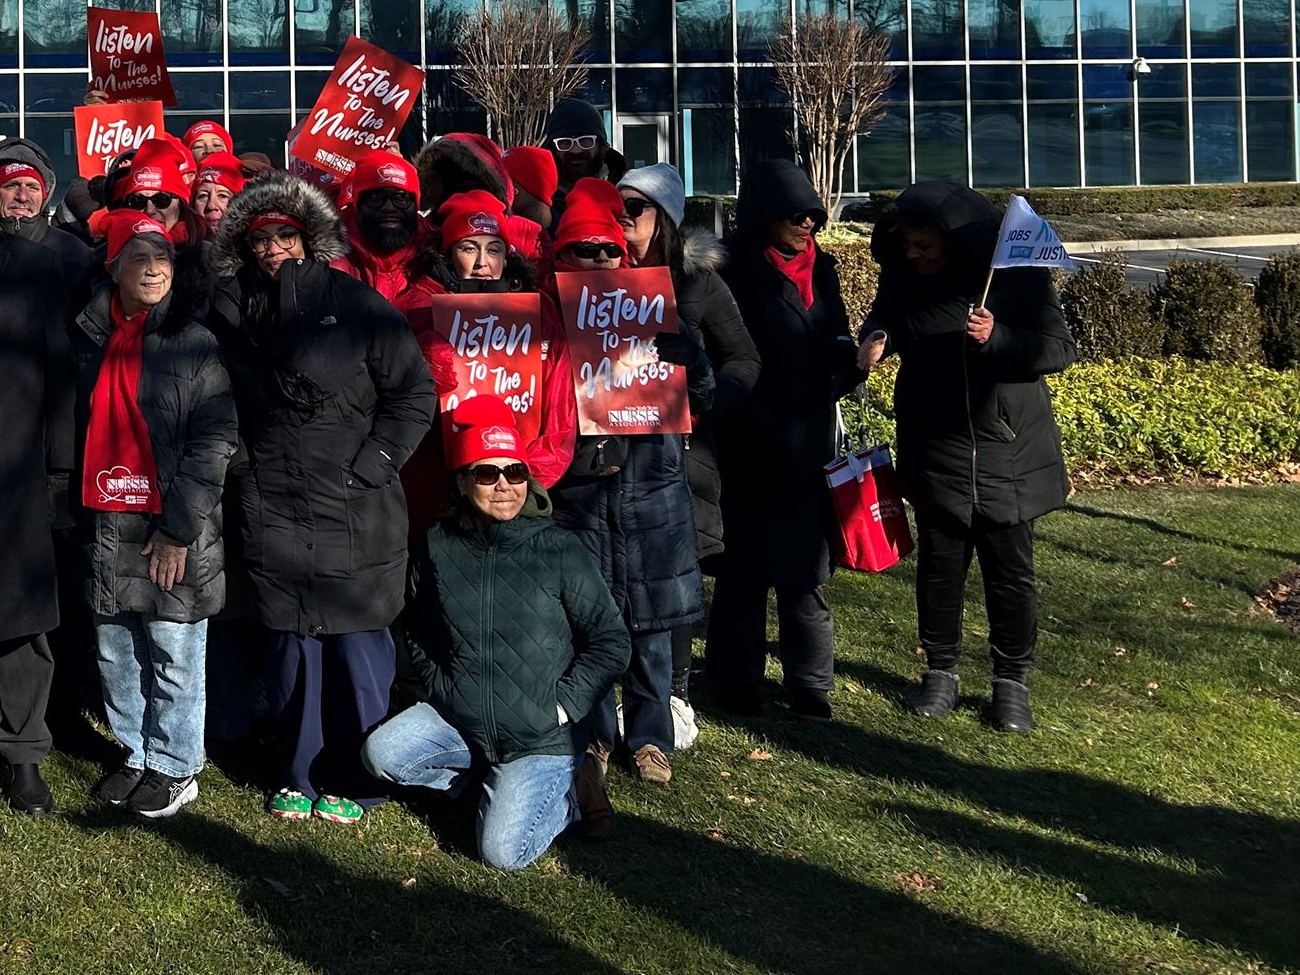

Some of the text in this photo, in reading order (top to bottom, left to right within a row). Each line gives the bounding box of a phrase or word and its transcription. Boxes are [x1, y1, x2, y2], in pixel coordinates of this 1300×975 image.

[94, 65, 162, 93] Nurses!
[310, 108, 396, 150] Nurses!
[1005, 229, 1032, 243] JOBS
[608, 410, 660, 422] NURSES
[106, 478, 150, 490] NURSES
